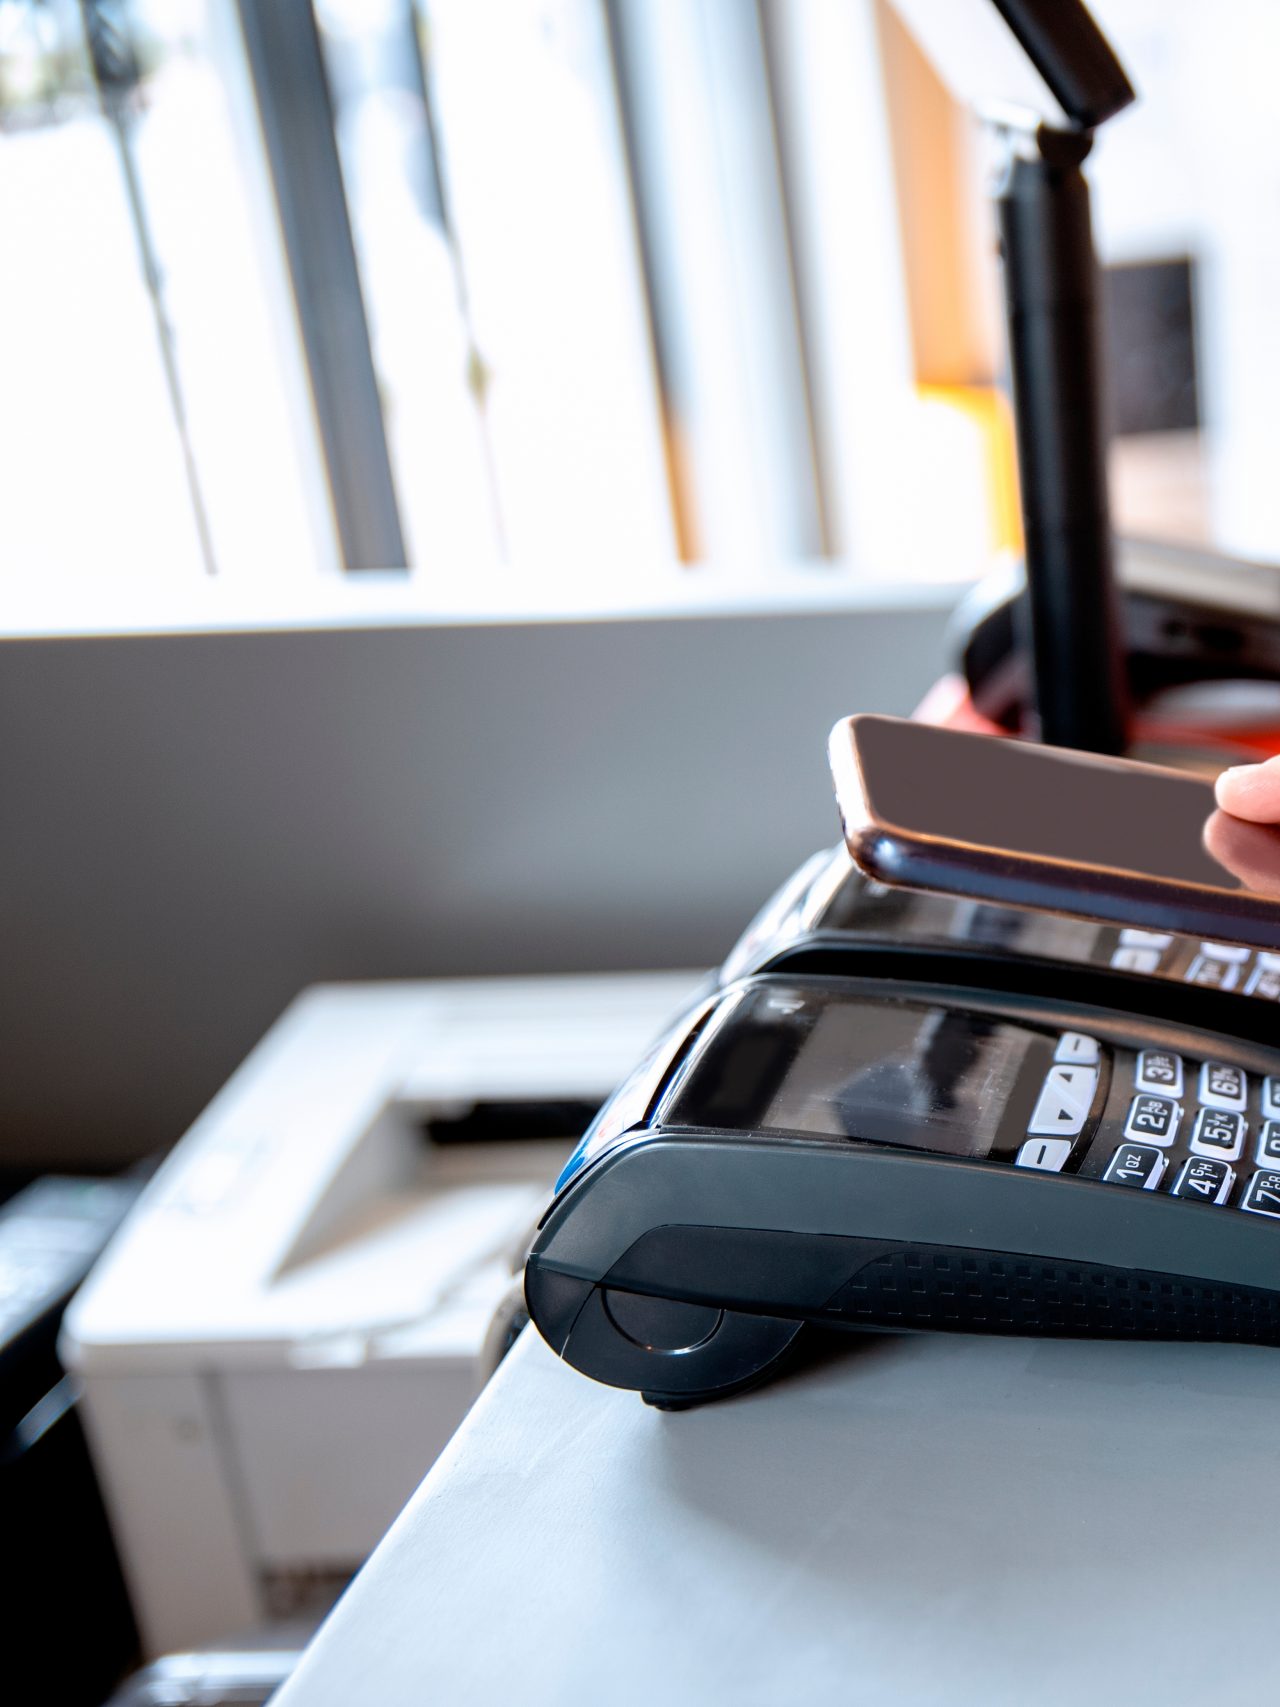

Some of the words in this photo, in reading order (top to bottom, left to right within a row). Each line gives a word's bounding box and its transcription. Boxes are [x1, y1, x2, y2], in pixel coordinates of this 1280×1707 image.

[1146, 1066, 1174, 1081] 3
[1211, 1081, 1239, 1096] 6
[1136, 1113, 1165, 1129] 2
[1203, 1126, 1232, 1141] 5
[1116, 1168, 1144, 1179] 1
[1188, 1178, 1217, 1195] 4
